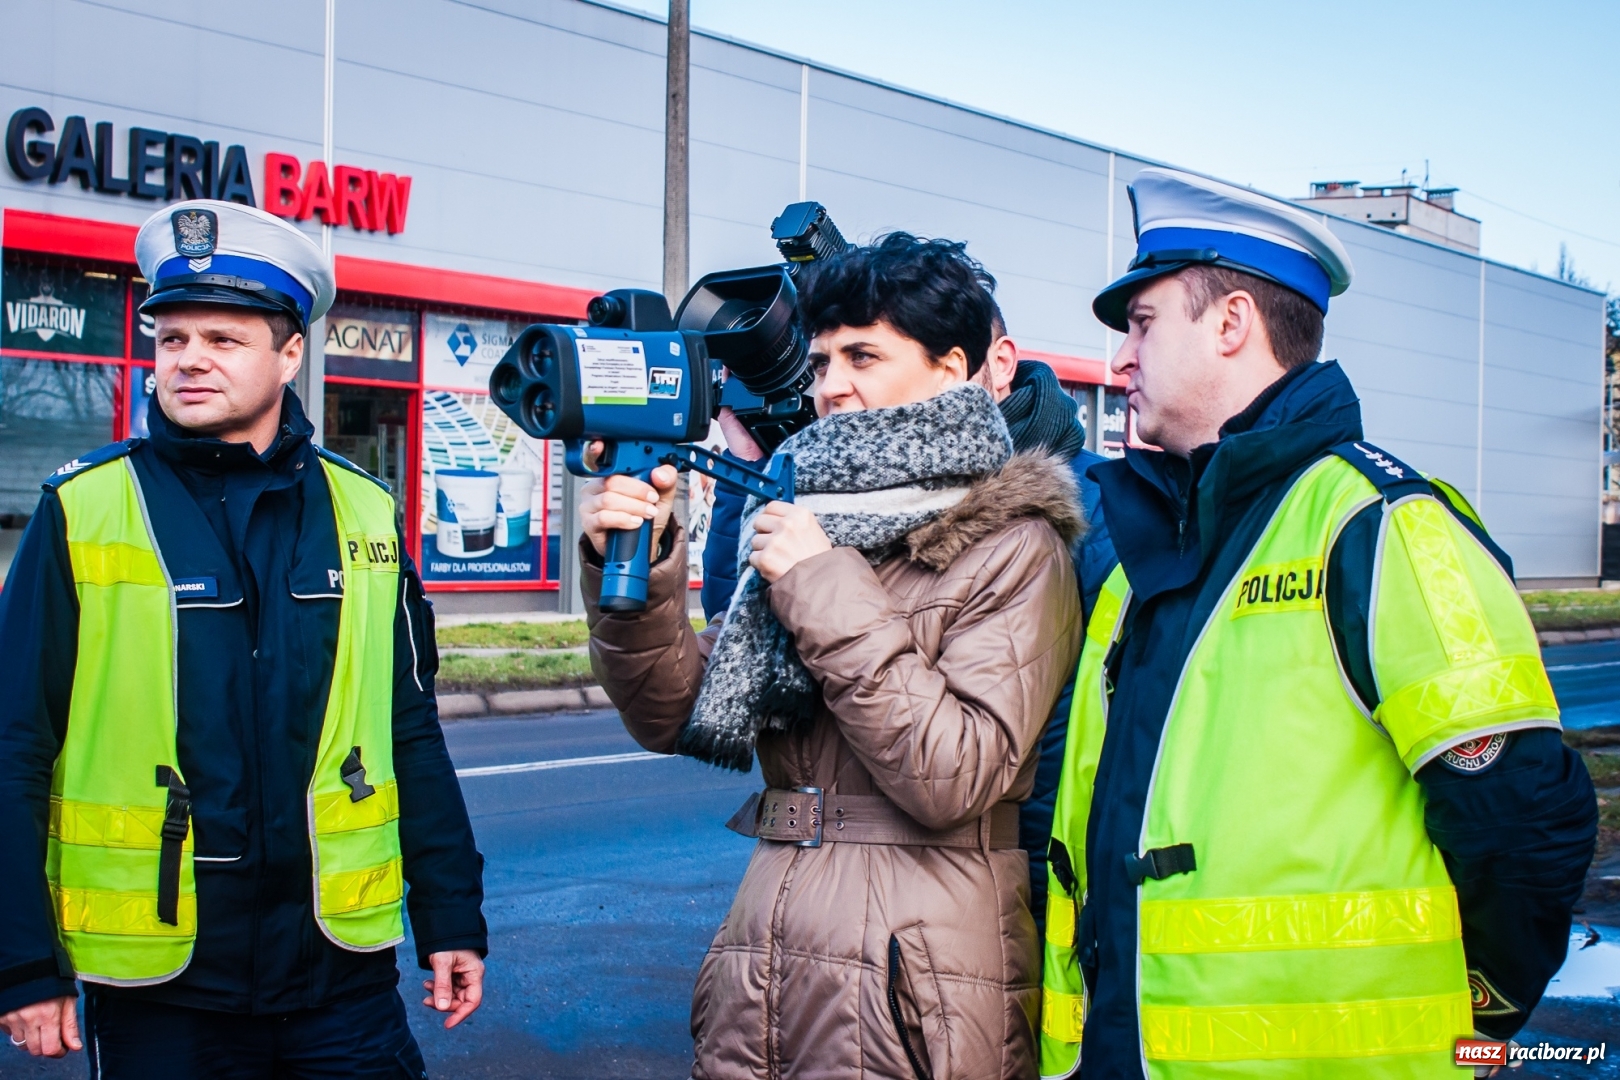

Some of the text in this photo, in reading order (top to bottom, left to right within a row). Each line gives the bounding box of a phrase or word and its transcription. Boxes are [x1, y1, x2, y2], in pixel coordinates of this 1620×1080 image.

[6, 106, 412, 235] GALERIA BARW
[180, 243, 211, 251] POLICJA
[6, 301, 86, 339] VIDARON
[324, 324, 408, 354] AGNAT
[481, 332, 514, 347] SIGMA
[481, 347, 505, 360] COAT
[1077, 404, 1126, 432] Cesit
[347, 540, 398, 564] PLICJ
[430, 561, 531, 573] FARBY DLA PROFESJONALISTÓW
[174, 583, 205, 591] NARSKI
[1444, 732, 1505, 768] RUCHU DROG
